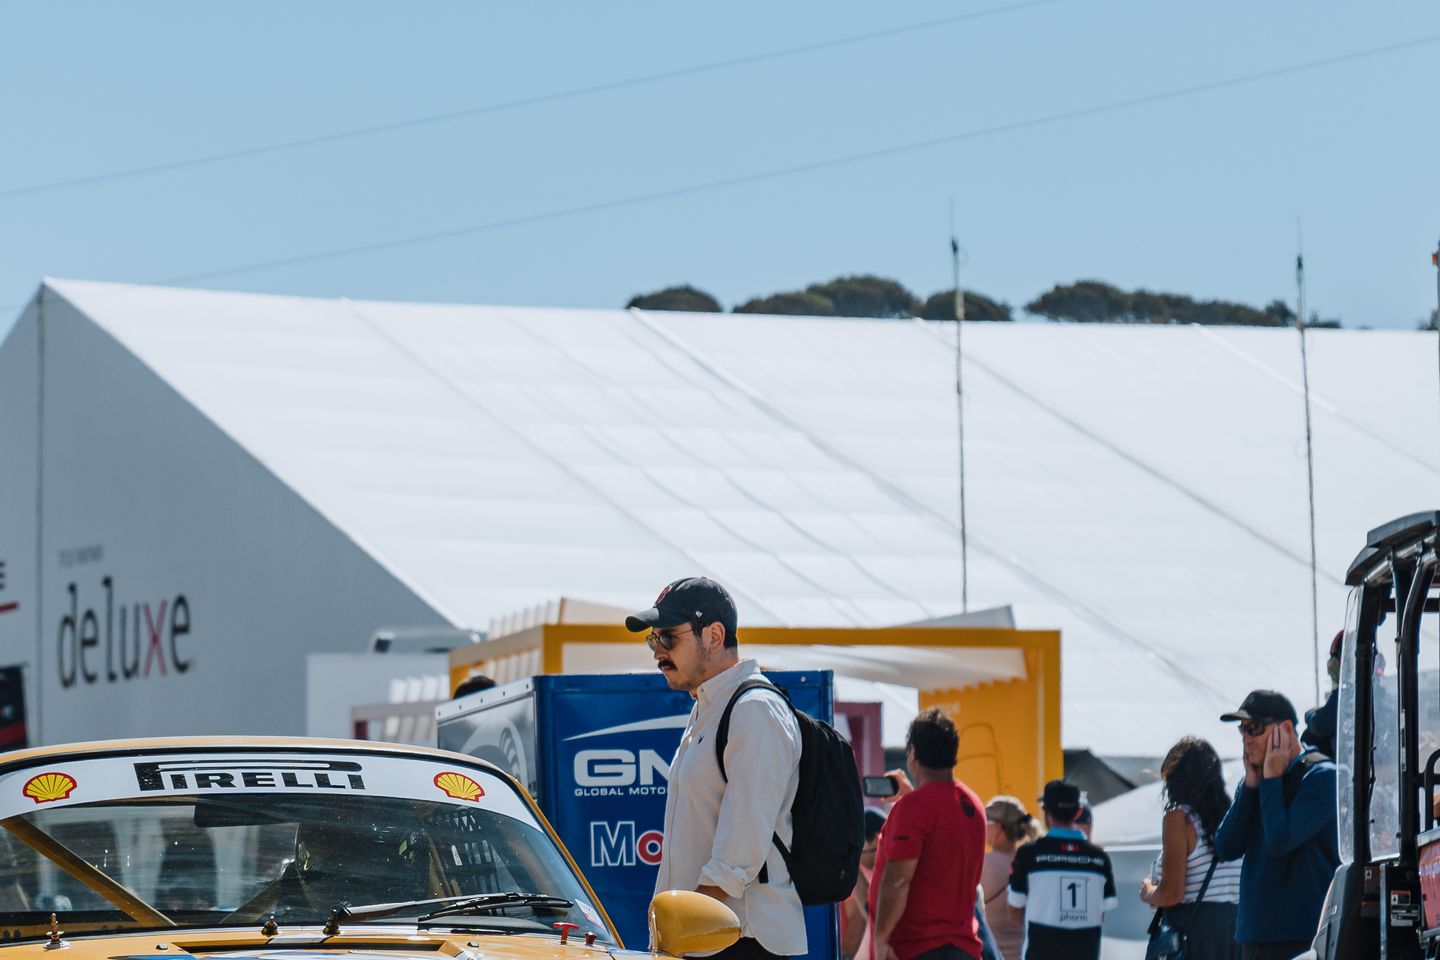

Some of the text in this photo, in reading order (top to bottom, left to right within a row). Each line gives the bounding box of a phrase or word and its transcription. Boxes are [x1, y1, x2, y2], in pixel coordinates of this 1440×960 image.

[57, 576, 191, 689] deluxe
[133, 759, 366, 791] PIRELLI
[574, 788, 624, 797] GLOBAL
[1036, 854, 1104, 867] PORSCHE
